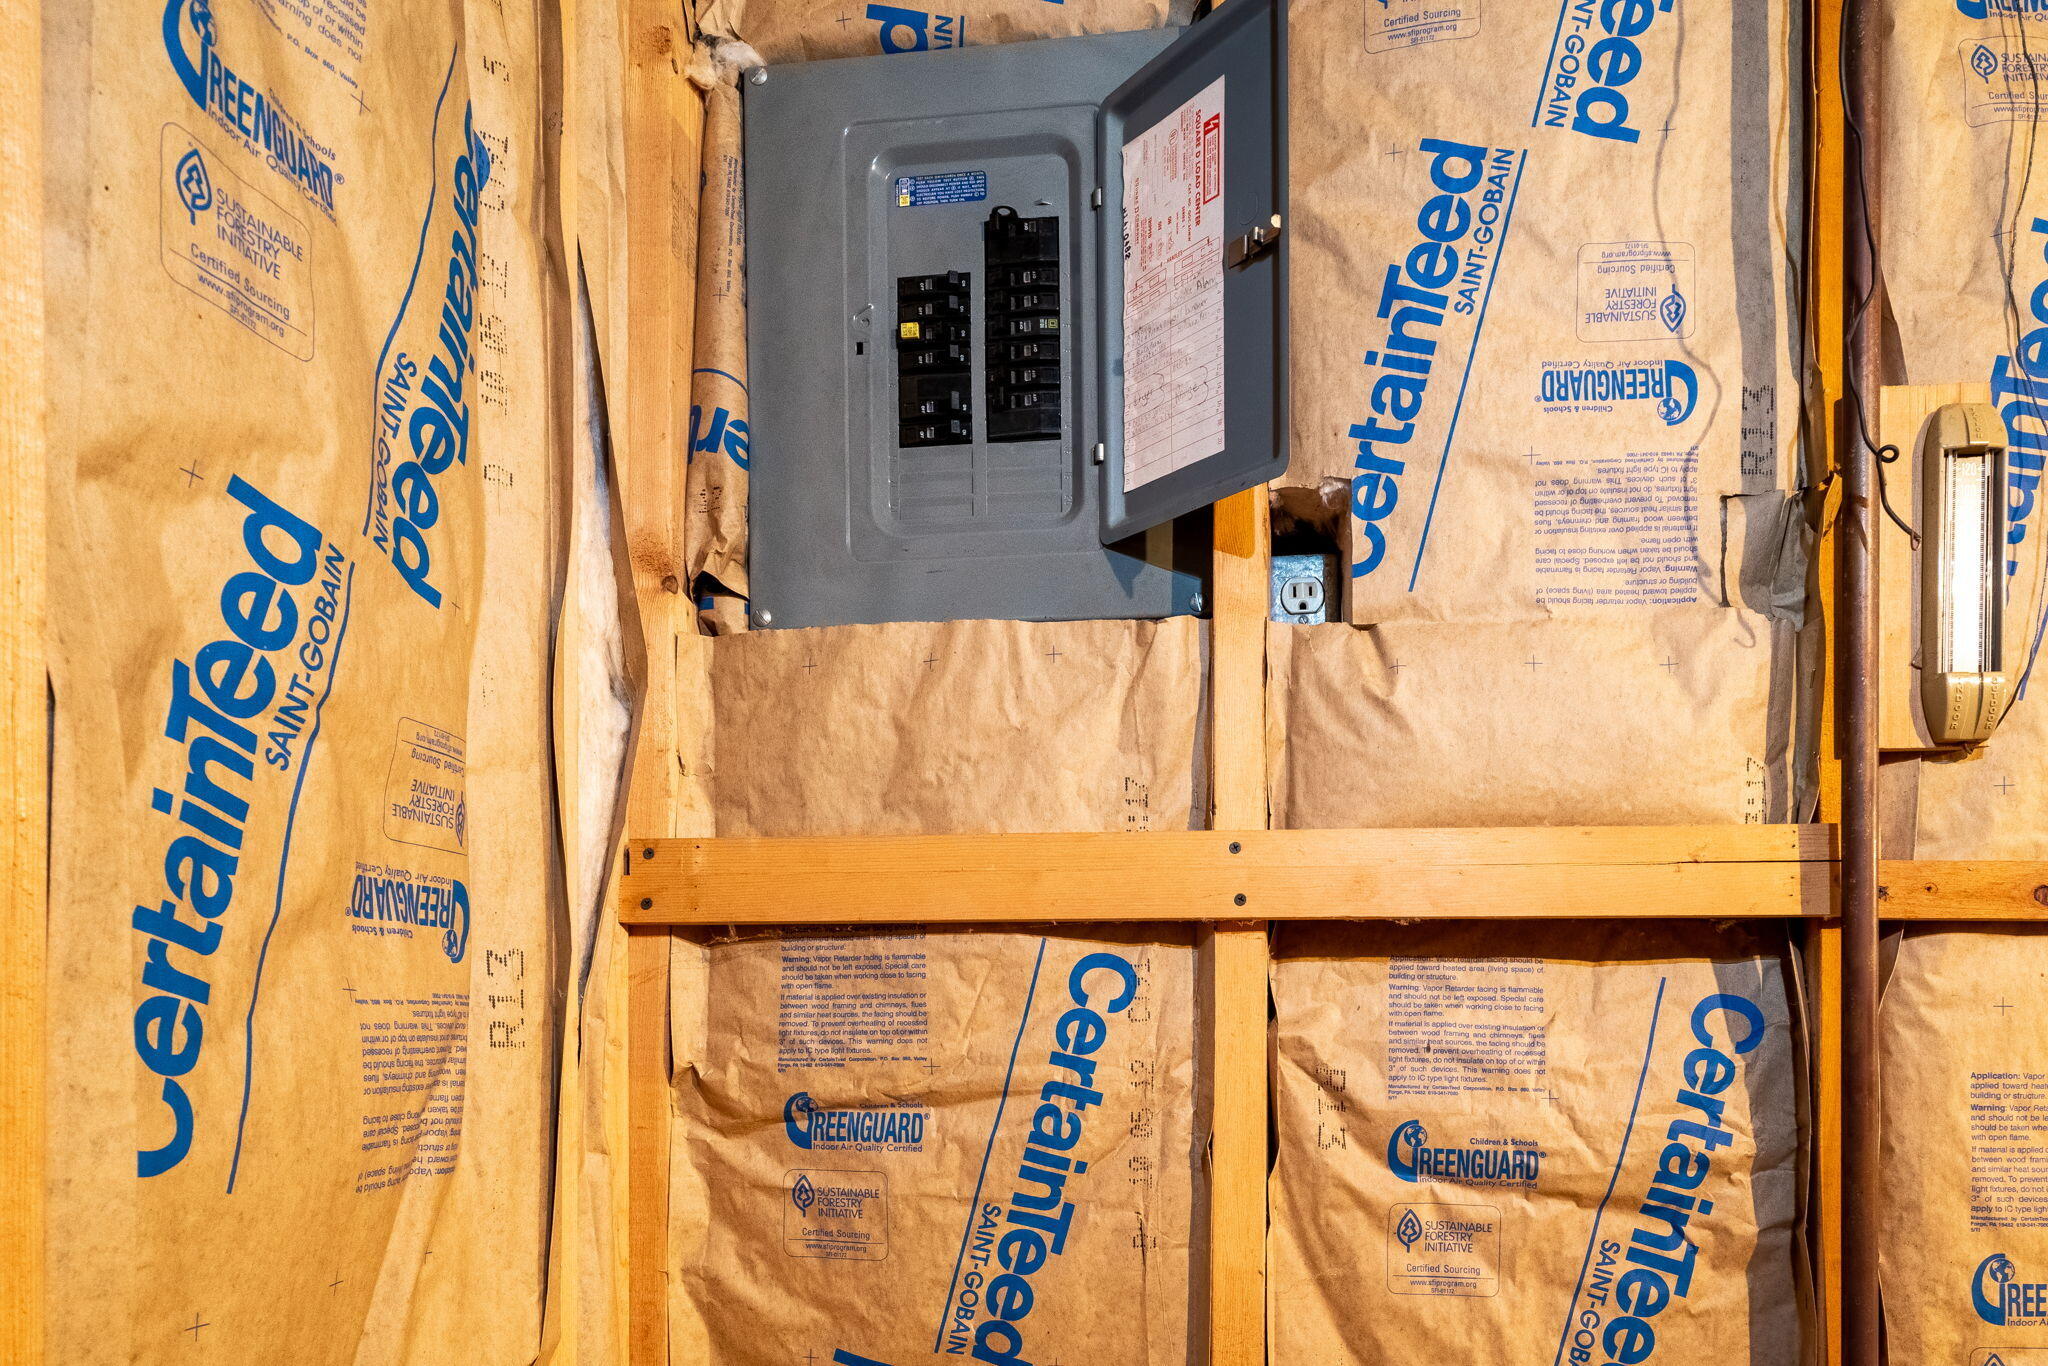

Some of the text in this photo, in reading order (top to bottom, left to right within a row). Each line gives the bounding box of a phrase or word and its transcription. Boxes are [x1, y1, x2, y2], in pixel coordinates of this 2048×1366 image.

[1384, 9, 1461, 27] Certified Sourcing
[318, 25, 342, 48] does
[1388, 23, 1457, 40] www.sfiprogram.org
[216, 188, 303, 262] SUSTAINABLE
[217, 207, 280, 260] FORESTRY
[1454, 148, 1516, 315] SAINT-GOBAIN
[217, 225, 281, 280] INITIATIVE
[1597, 264, 1675, 275] Certified Sourcing
[191, 243, 241, 284] Certified
[244, 278, 291, 320] Sourcing
[1604, 286, 1657, 298] INITIATIVE
[1605, 298, 1657, 310] FORESTRY
[1585, 309, 1657, 323] SUSTAINABLE
[1541, 361, 1580, 369] Certified
[1583, 359, 1614, 369] Quality
[1634, 359, 1663, 367] Indoor
[1544, 405, 1613, 414] Children & Schools
[372, 351, 417, 555] SAINT-GOBAIN
[1665, 577, 1697, 585] building
[1649, 596, 1697, 604] Application:
[265, 542, 346, 772] SAINT-GOBAIN
[411, 748, 441, 769] Sourcing
[411, 779, 455, 802] INITIATIVE
[409, 794, 455, 815] FORESTRY
[391, 803, 454, 829] SUSTAINABLE
[132, 473, 323, 1178] CertainTeed
[384, 865, 411, 882] Quality
[415, 873, 428, 885] Air
[429, 875, 452, 888] Indoor
[351, 924, 377, 936] Schools
[1388, 984, 1421, 992] Warning:
[1971, 1072, 2045, 1080] Application: Vapor
[1971, 1082, 1999, 1090] applied
[1971, 1092, 2001, 1100] building
[2012, 1092, 2047, 1100] structure.
[2009, 1105, 2031, 1113] Vapor
[813, 1142, 839, 1150] Indoor
[855, 1143, 884, 1153] Quality
[886, 1144, 923, 1153] Certified
[1469, 1137, 1500, 1146] Children
[1510, 1138, 1539, 1147] Schools
[971, 952, 1138, 1366] CertainTeed
[1420, 1176, 1538, 1190] Indoor Air Quality Certified
[817, 1187, 880, 1199] SUSTAINABLE
[818, 1198, 863, 1208] FORESTRY
[818, 1208, 863, 1219] INITIATIVE
[1425, 1221, 1493, 1233] SUSTAINABLE
[802, 1228, 871, 1241] Certified Sourcing
[1425, 1232, 1473, 1242] FORESTRY
[1424, 1242, 1473, 1253] INITIATIVE
[1406, 1263, 1481, 1275] Certified Sourcing
[946, 1201, 1002, 1356] SAINT-GOBAIN
[1410, 1279, 1477, 1289] www.sfiprogram.org
